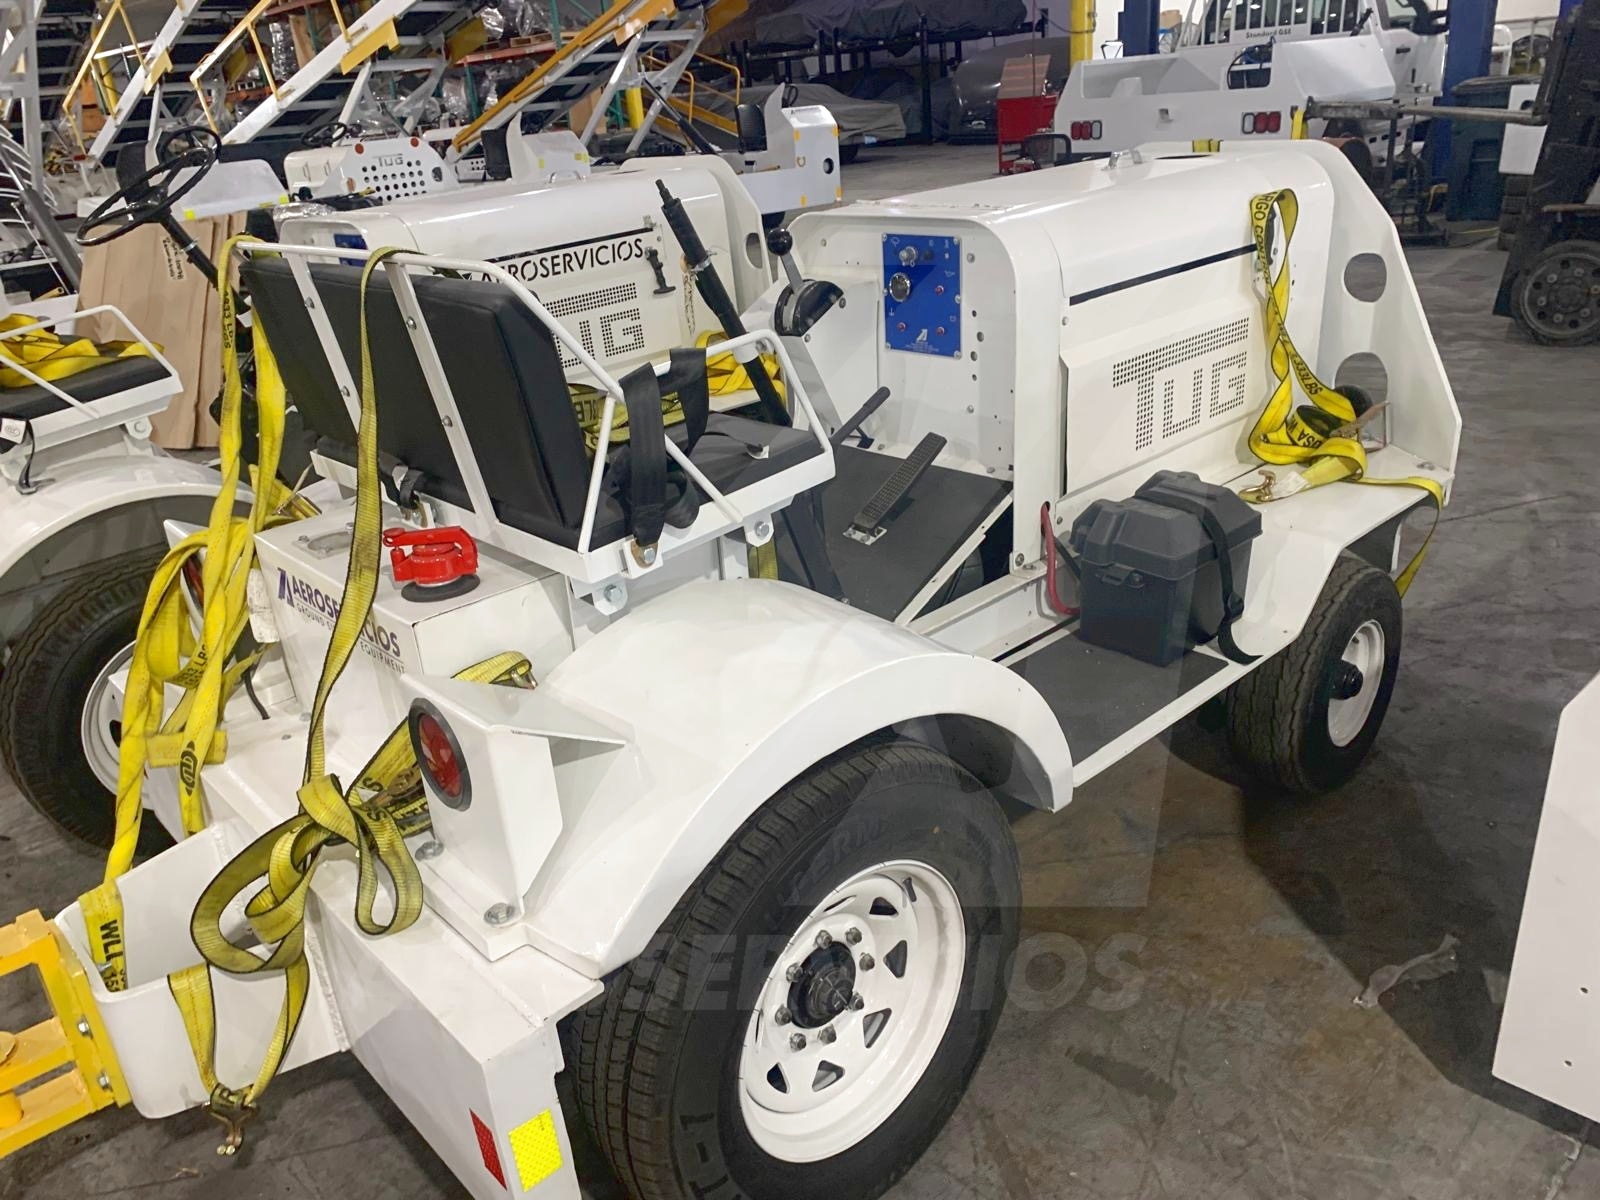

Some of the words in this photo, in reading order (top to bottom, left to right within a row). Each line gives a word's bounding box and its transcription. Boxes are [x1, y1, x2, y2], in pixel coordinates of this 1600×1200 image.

[1246, 30, 1277, 39] Standard
[1278, 28, 1291, 36] GSE
[372, 153, 404, 167] TUG
[481, 238, 644, 283] AROSERVICIOS
[1113, 317, 1250, 451] TUG
[297, 603, 326, 627] GROUND
[360, 641, 406, 674] EQUIPMENT
[100, 919, 124, 962] WLL
